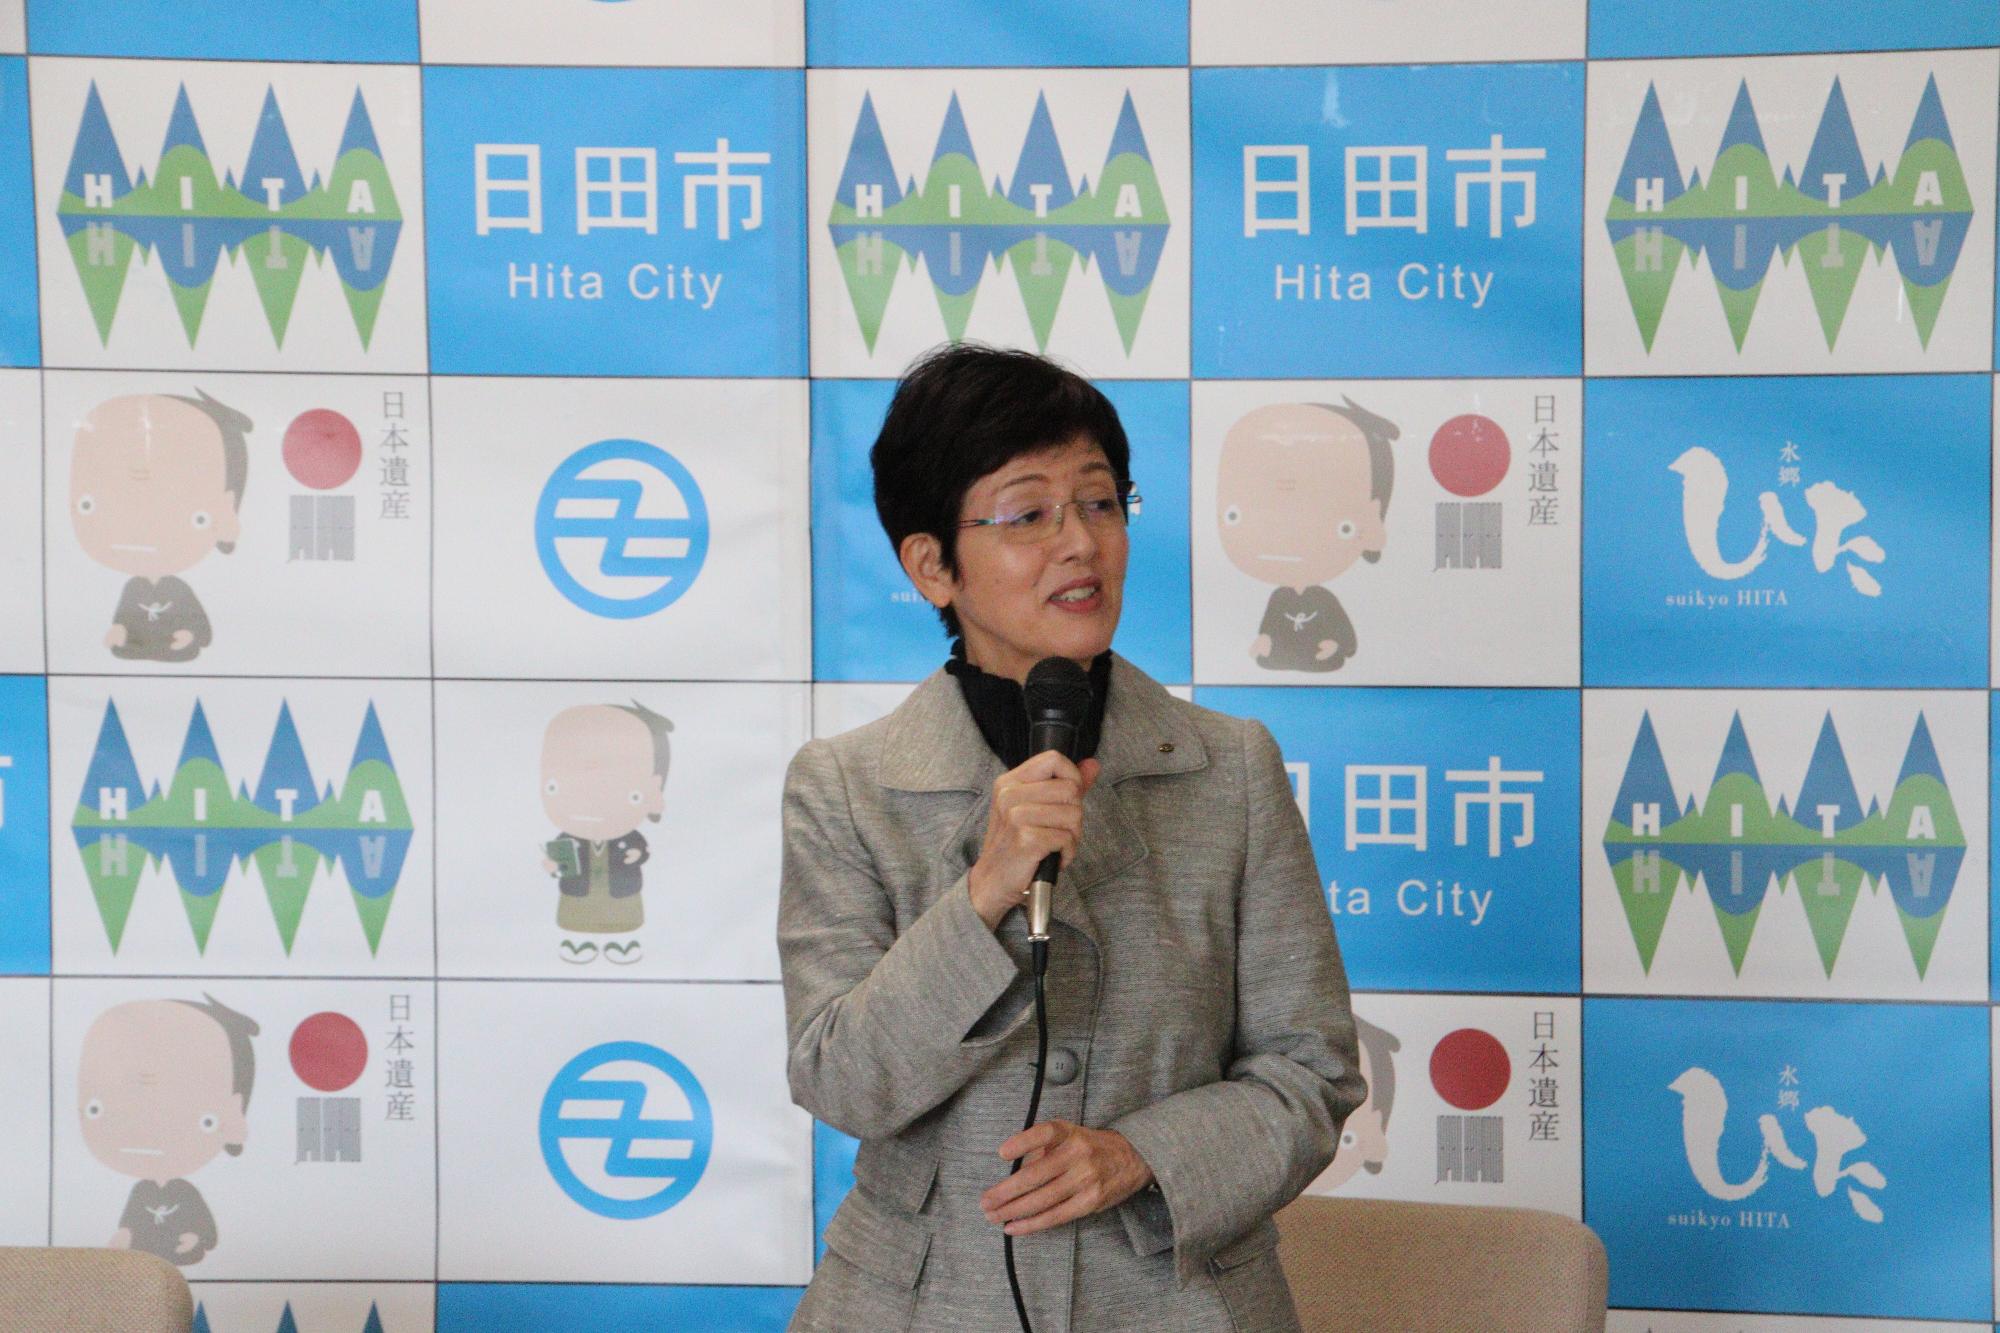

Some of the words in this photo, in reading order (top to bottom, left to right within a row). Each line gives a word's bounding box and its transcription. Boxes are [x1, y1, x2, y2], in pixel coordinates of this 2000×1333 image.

[84, 173, 376, 214] HITA
[474, 137, 772, 241] 日田市
[855, 183, 1143, 218] HITA
[1242, 132, 1547, 240] 日田市
[1634, 170, 1944, 213] HITA
[508, 262, 604, 300] Hita
[628, 263, 724, 310] City
[1274, 262, 1372, 301] Hita
[1397, 263, 1495, 310] City
[378, 391, 411, 521] 日本遺産
[1526, 394, 1561, 527] 日本遺産
[1777, 440, 1802, 487] 水郷
[1668, 446, 1887, 599] ひた
[1665, 590, 1730, 609] suikyo
[1737, 589, 1789, 606] HITA
[100, 786, 387, 823] HITA
[1632, 801, 1937, 840] HITA
[1326, 879, 1371, 916] ta
[1396, 878, 1494, 926] City
[384, 993, 416, 1123] 日本遺産
[1528, 1010, 1561, 1143] 日本遺産
[1667, 1066, 1887, 1225] ひた
[1667, 1209, 1731, 1229] suikyo
[1738, 1210, 1790, 1229] HITA
